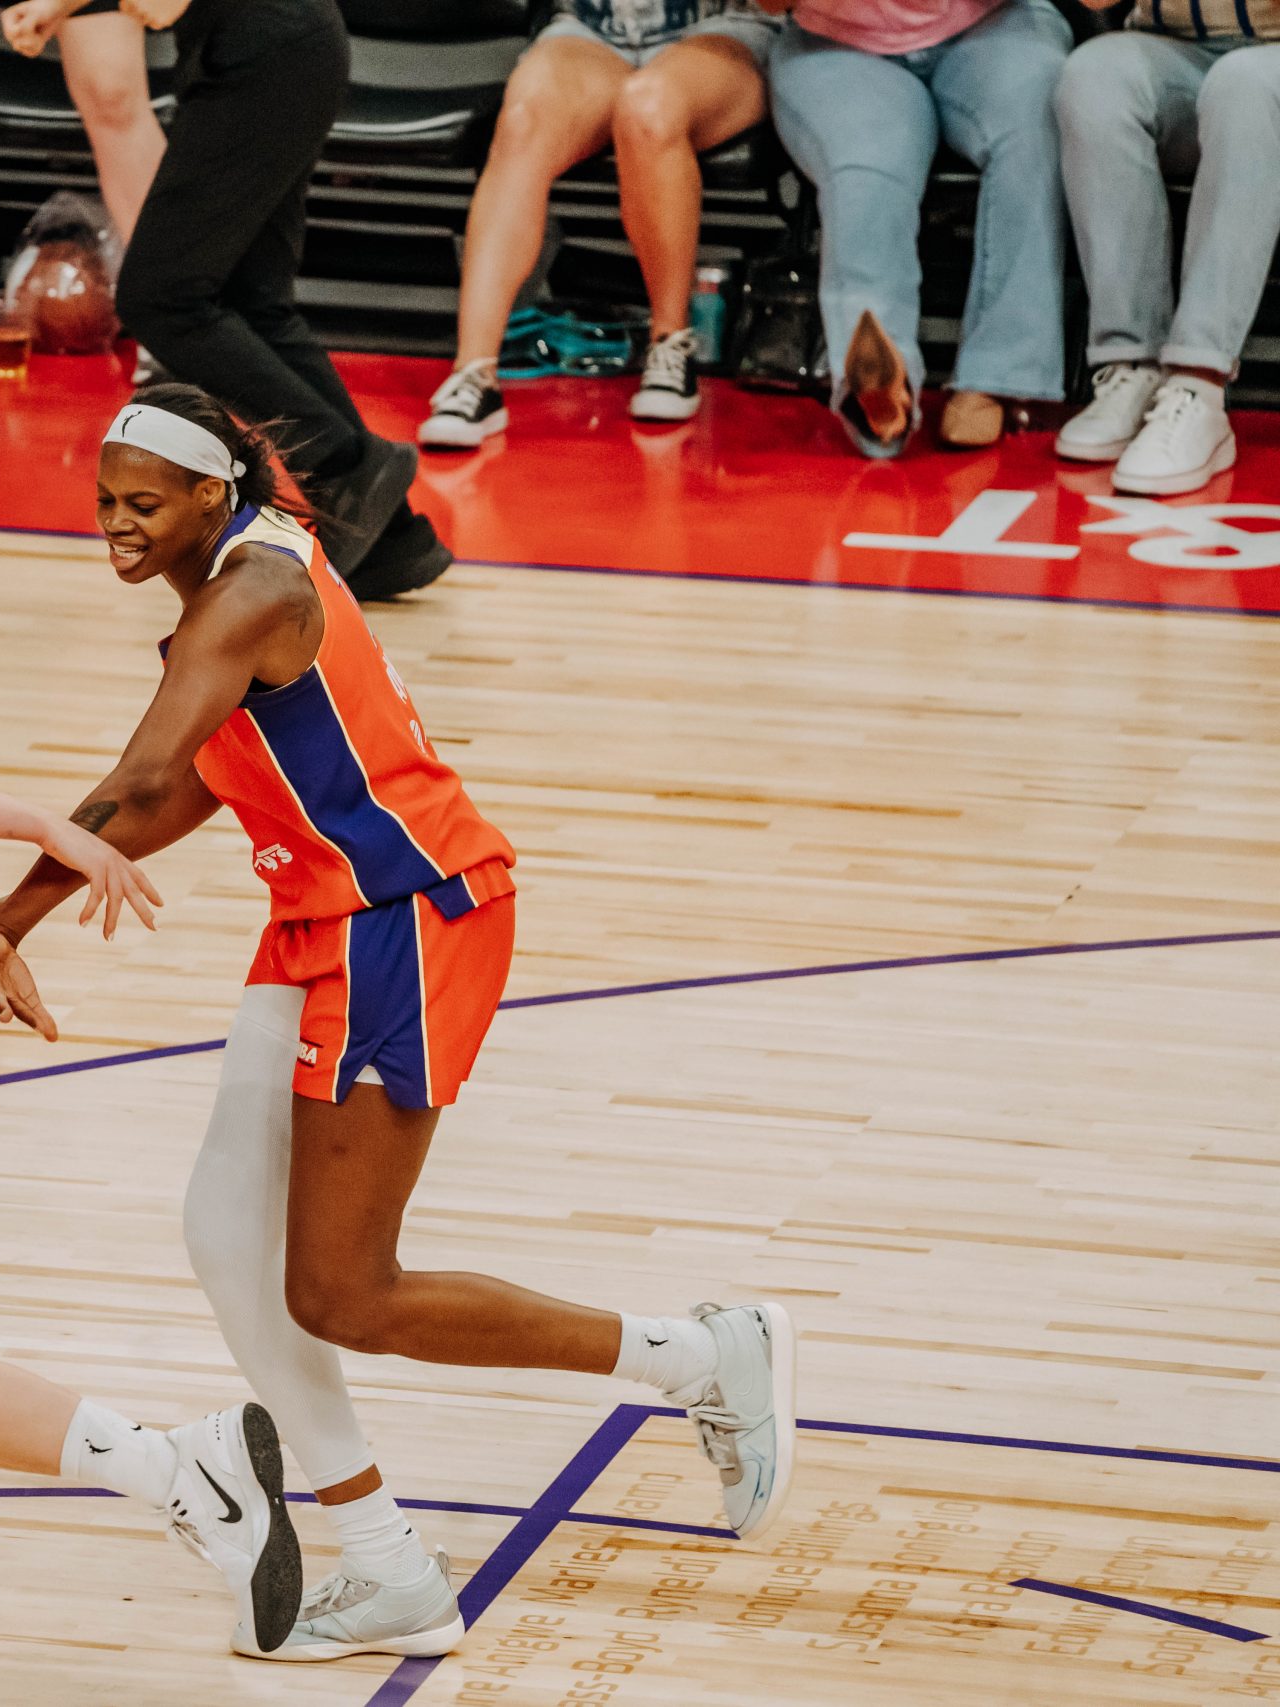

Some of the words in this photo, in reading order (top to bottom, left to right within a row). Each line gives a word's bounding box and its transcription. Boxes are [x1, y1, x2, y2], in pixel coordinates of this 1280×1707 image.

[842, 490, 1280, 571] &T
[298, 1041, 318, 1064] BA
[577, 1472, 694, 1546] Akamp
[517, 1541, 623, 1607] Marlies
[706, 1563, 822, 1641] Monique
[772, 1501, 880, 1562] Billings
[804, 1578, 918, 1653] Susanna
[867, 1499, 982, 1577] Bonfiglio
[959, 1530, 1067, 1596] Braxton
[1024, 1602, 1116, 1656] Edwin
[1074, 1535, 1173, 1590] Brown
[1171, 1539, 1277, 1609] Brunner
[462, 1614, 566, 1678] Anigwe
[557, 1628, 663, 1707] ass-Boyd
[614, 1556, 722, 1622] Ryneldi
[923, 1599, 1012, 1641] Kara
[451, 1680, 510, 1707] ne
